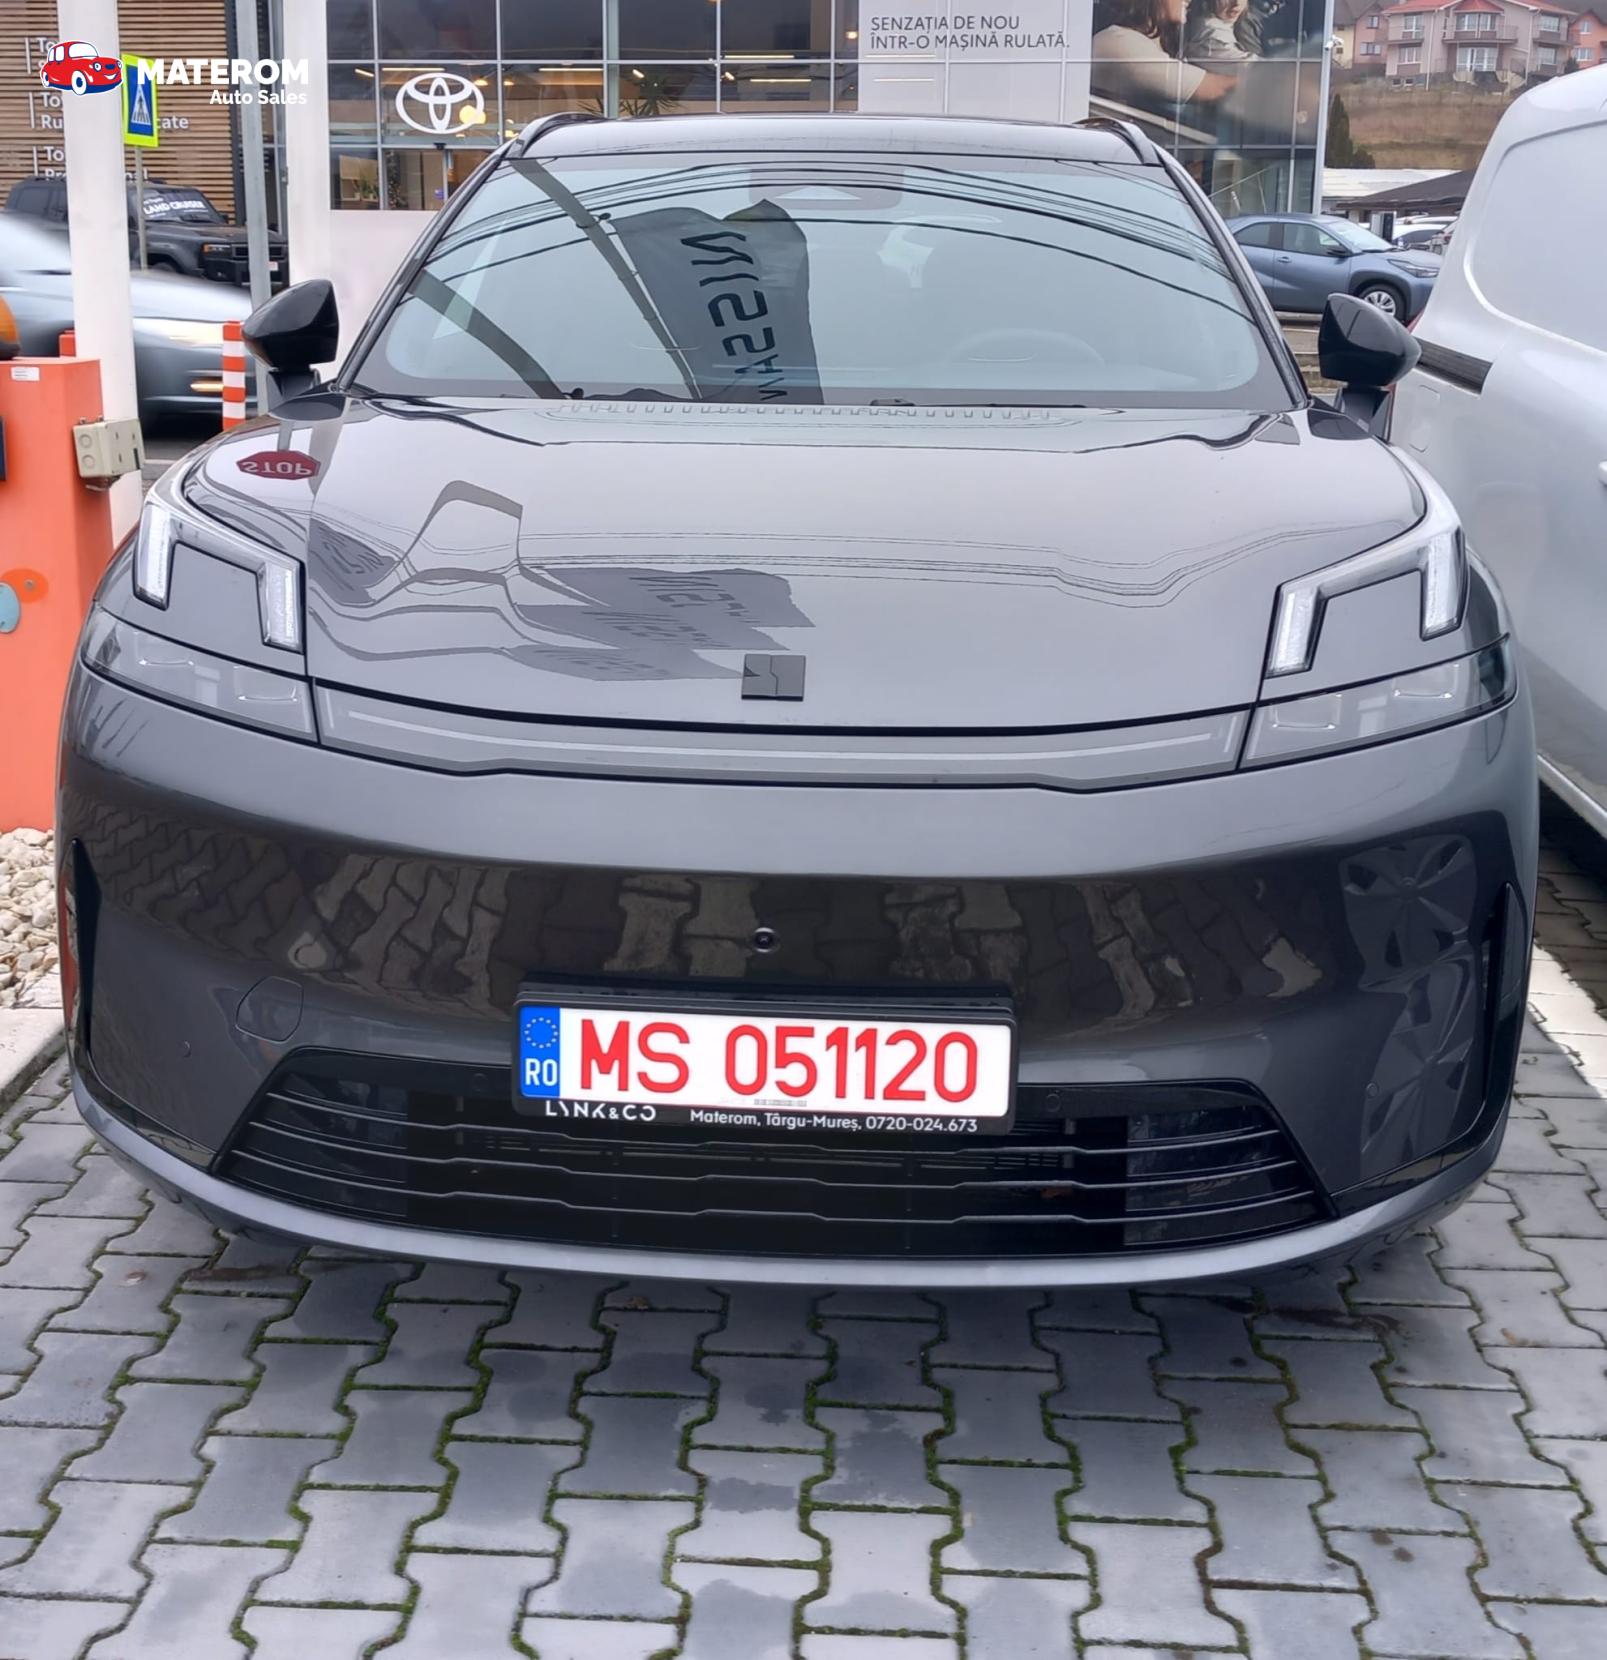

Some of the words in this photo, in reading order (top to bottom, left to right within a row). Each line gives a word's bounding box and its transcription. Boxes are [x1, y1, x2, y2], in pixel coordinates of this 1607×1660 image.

[871, 16, 949, 34] SENZAȚIA
[953, 15, 975, 30] DE
[980, 15, 1020, 30] NOU
[870, 33, 930, 49] ÎNTR-O
[934, 32, 999, 51] MAȘINĂ
[1003, 31, 1070, 49] RULATĂ.
[525, 1058, 558, 1086] RO
[580, 1019, 690, 1093] MS
[725, 1024, 978, 1103] 051120
[690, 1109, 761, 1126] Materom,
[765, 1112, 863, 1132] Târgu-Mureș,
[865, 1116, 978, 1133] 0720-024.673
